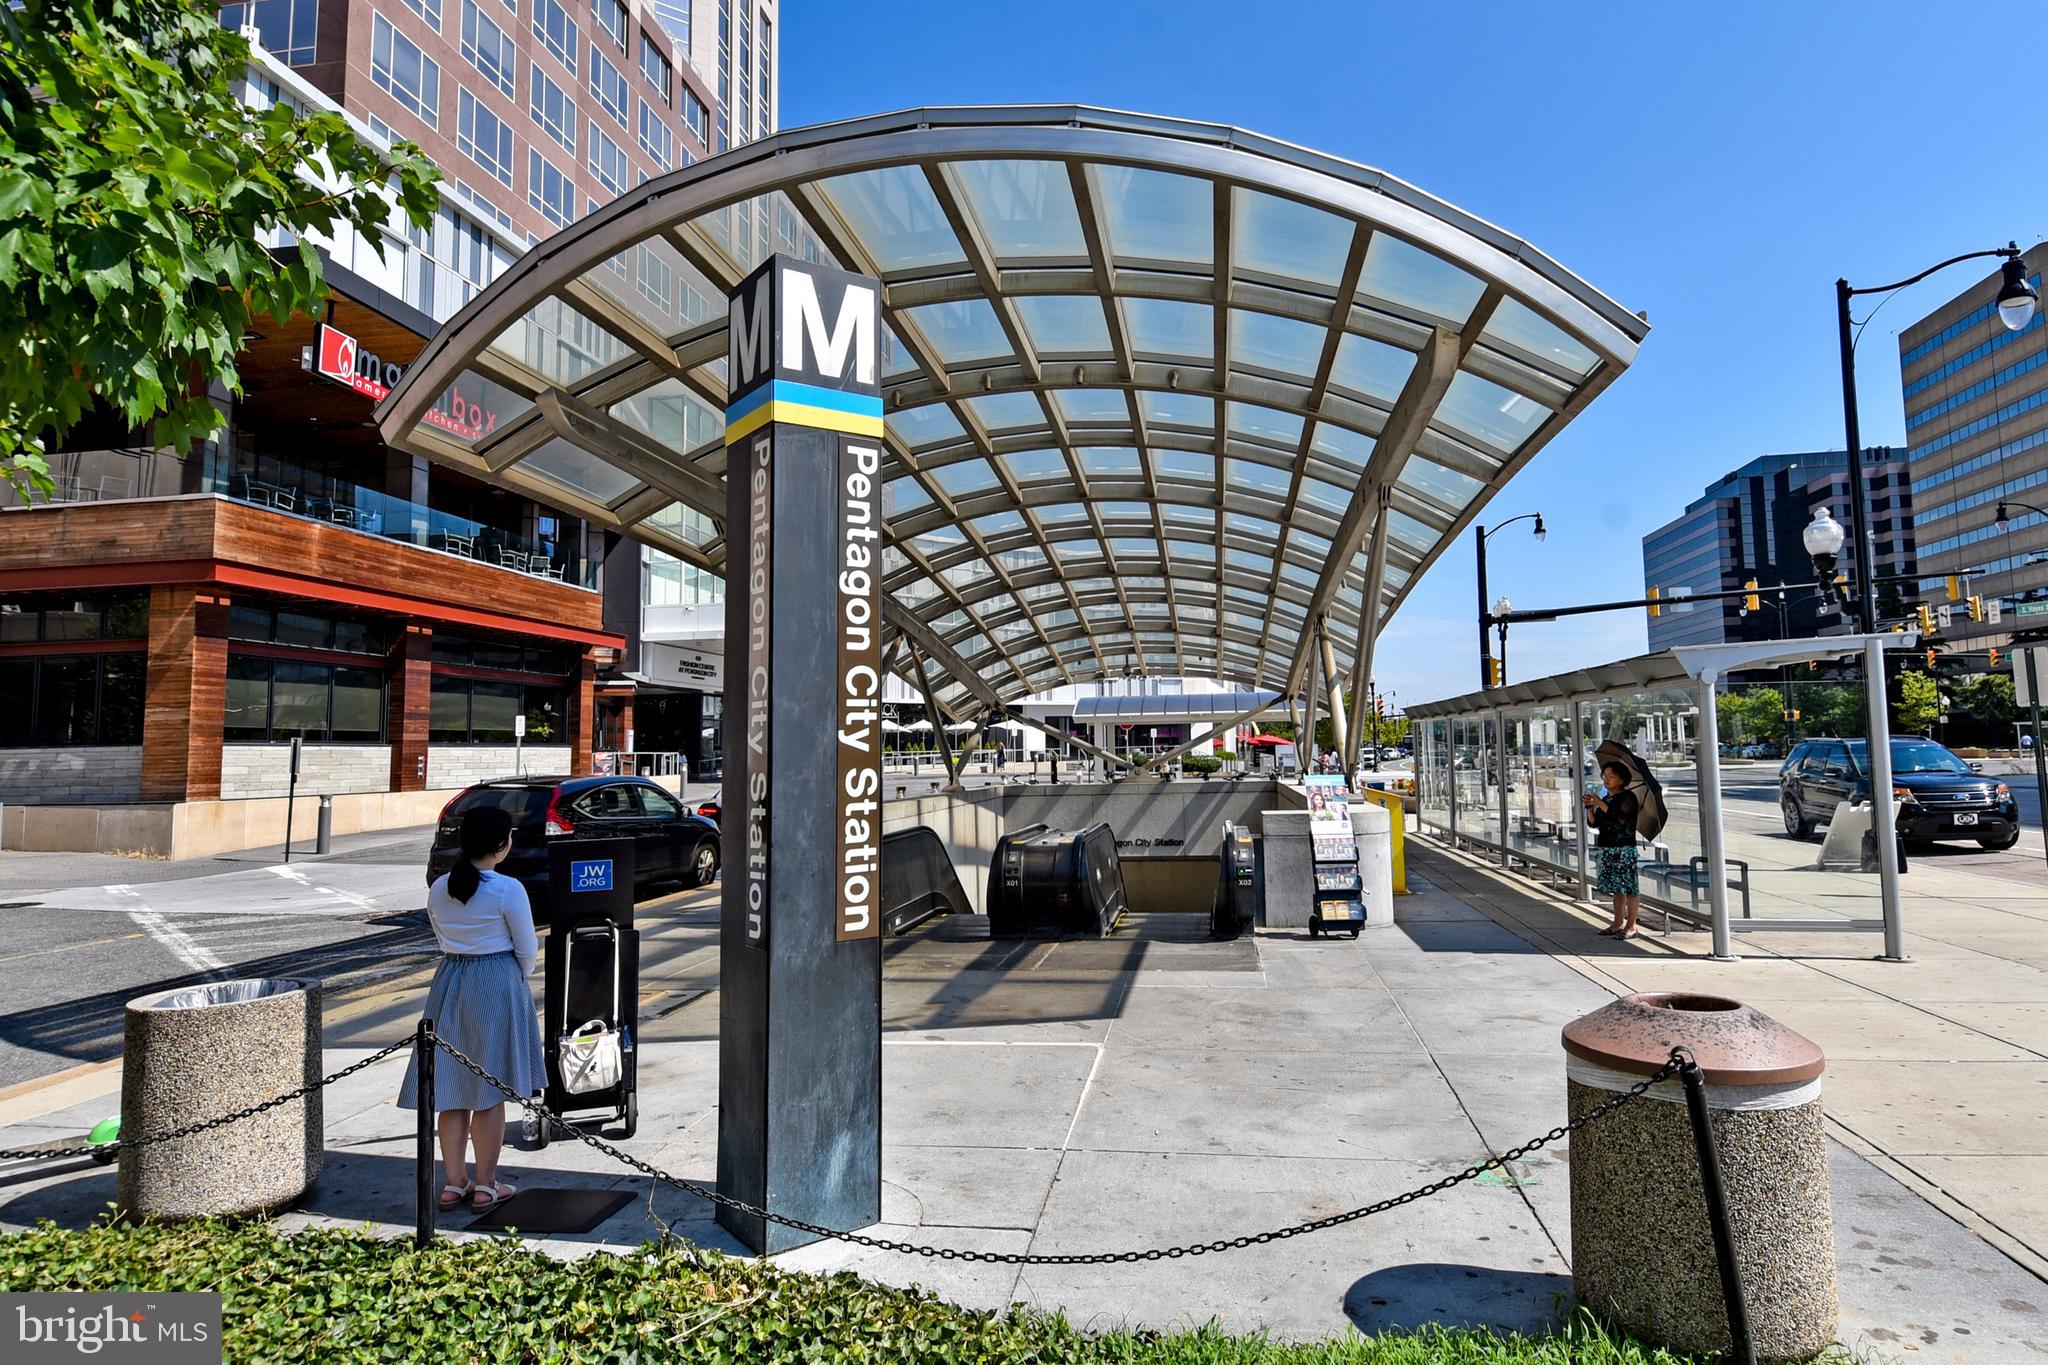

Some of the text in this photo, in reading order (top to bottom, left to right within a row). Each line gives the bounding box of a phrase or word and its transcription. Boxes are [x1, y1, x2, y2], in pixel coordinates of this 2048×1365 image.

[730, 270, 770, 395] M
[783, 268, 875, 385] M
[748, 437, 771, 940] Pentagon City Station
[838, 445, 878, 932] Pentagon City Station
[882, 703, 897, 716] CK
[579, 864, 605, 878] JW
[1135, 837, 1151, 848] City
[1154, 837, 1184, 847] Station
[577, 877, 606, 888] .ORG
